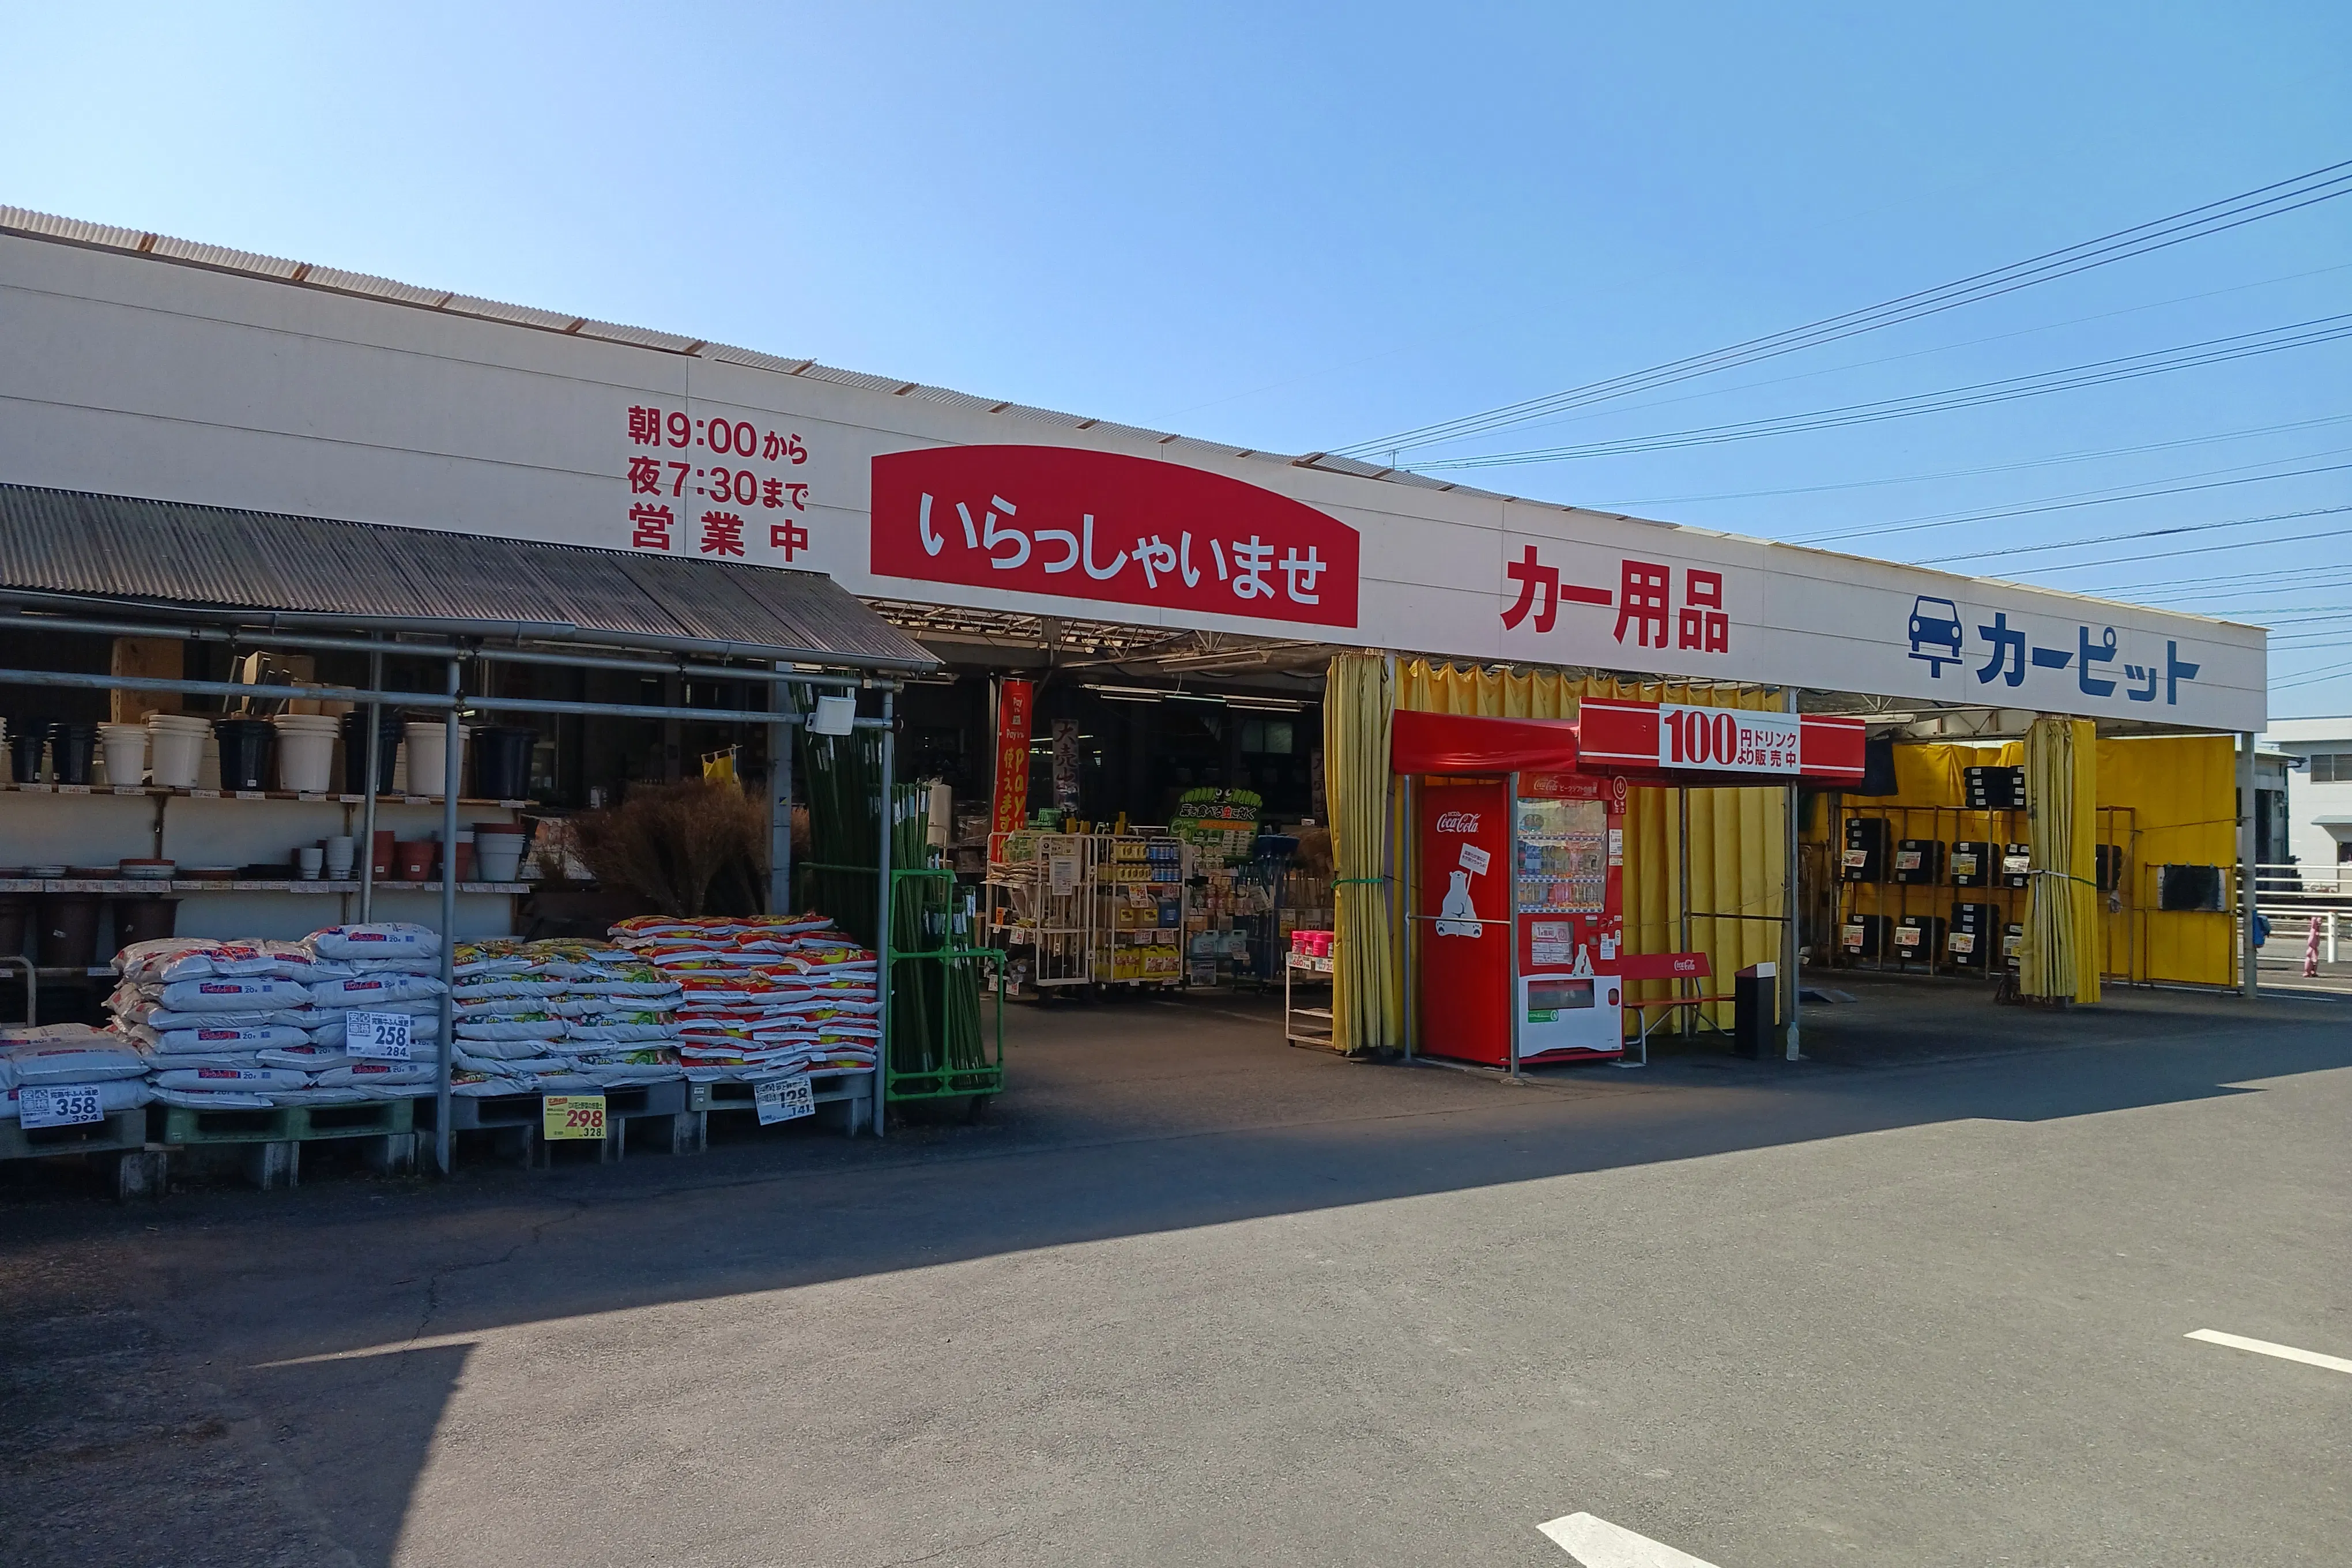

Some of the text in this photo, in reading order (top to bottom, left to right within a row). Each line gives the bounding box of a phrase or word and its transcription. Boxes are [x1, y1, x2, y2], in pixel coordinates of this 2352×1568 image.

[628, 405, 808, 465] 朝9:00から
[627, 455, 809, 512] 夜7:30まで
[629, 502, 808, 563] 営業中
[919, 492, 1326, 604] いらっしゃいませ
[1500, 545, 1728, 654] カー用品
[1976, 612, 2201, 706] カーピット
[1664, 710, 1737, 765] 100
[1740, 729, 1796, 748] 円ドリンク
[1737, 748, 1796, 768] より販売中
[1437, 813, 1482, 833] Coca-Cola
[375, 1025, 406, 1046] 258
[386, 1046, 406, 1057] 284
[55, 1096, 96, 1116] 358
[780, 1087, 808, 1109] 128
[72, 1114, 98, 1123] 394
[566, 1110, 603, 1128] 298
[792, 1104, 810, 1117] 141
[583, 1128, 601, 1137] 328
